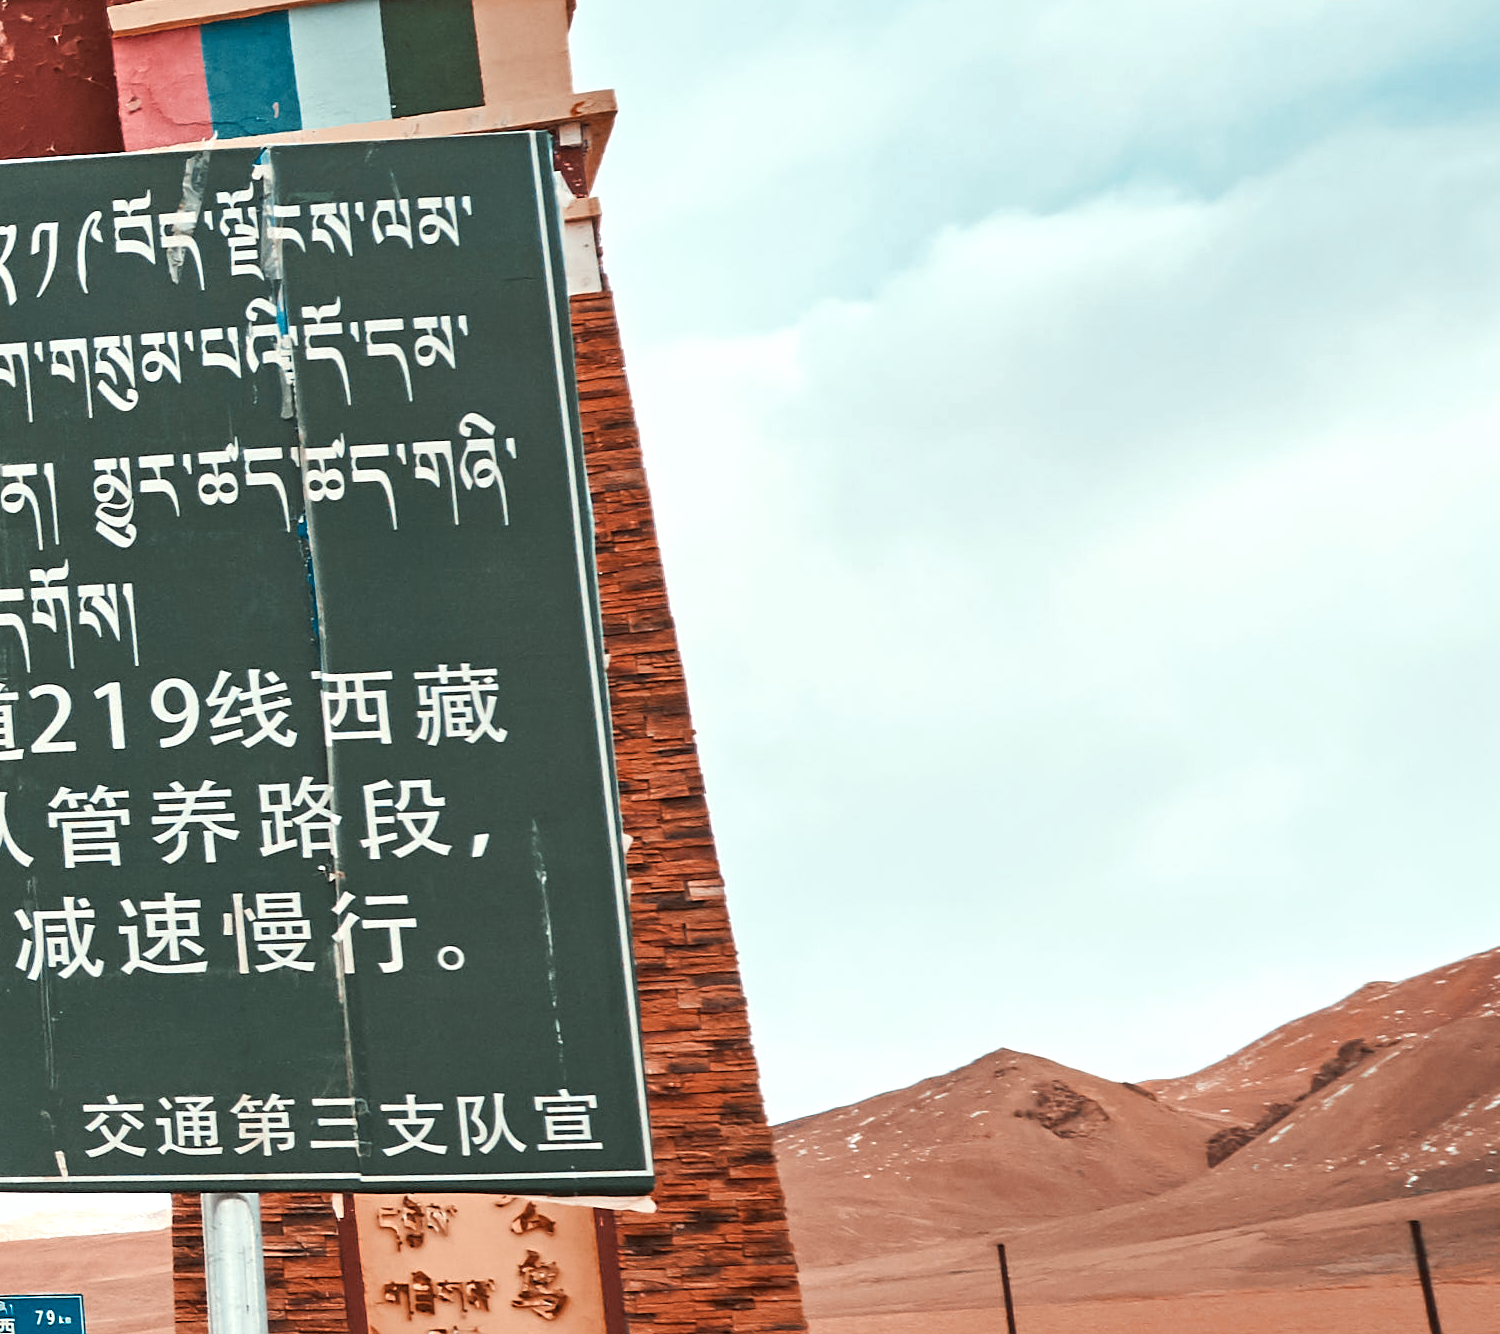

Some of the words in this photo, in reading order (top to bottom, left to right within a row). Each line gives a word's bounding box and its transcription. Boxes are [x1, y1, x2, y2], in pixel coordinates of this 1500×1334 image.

[82, 1088, 604, 1158] 交通第三支队宣
